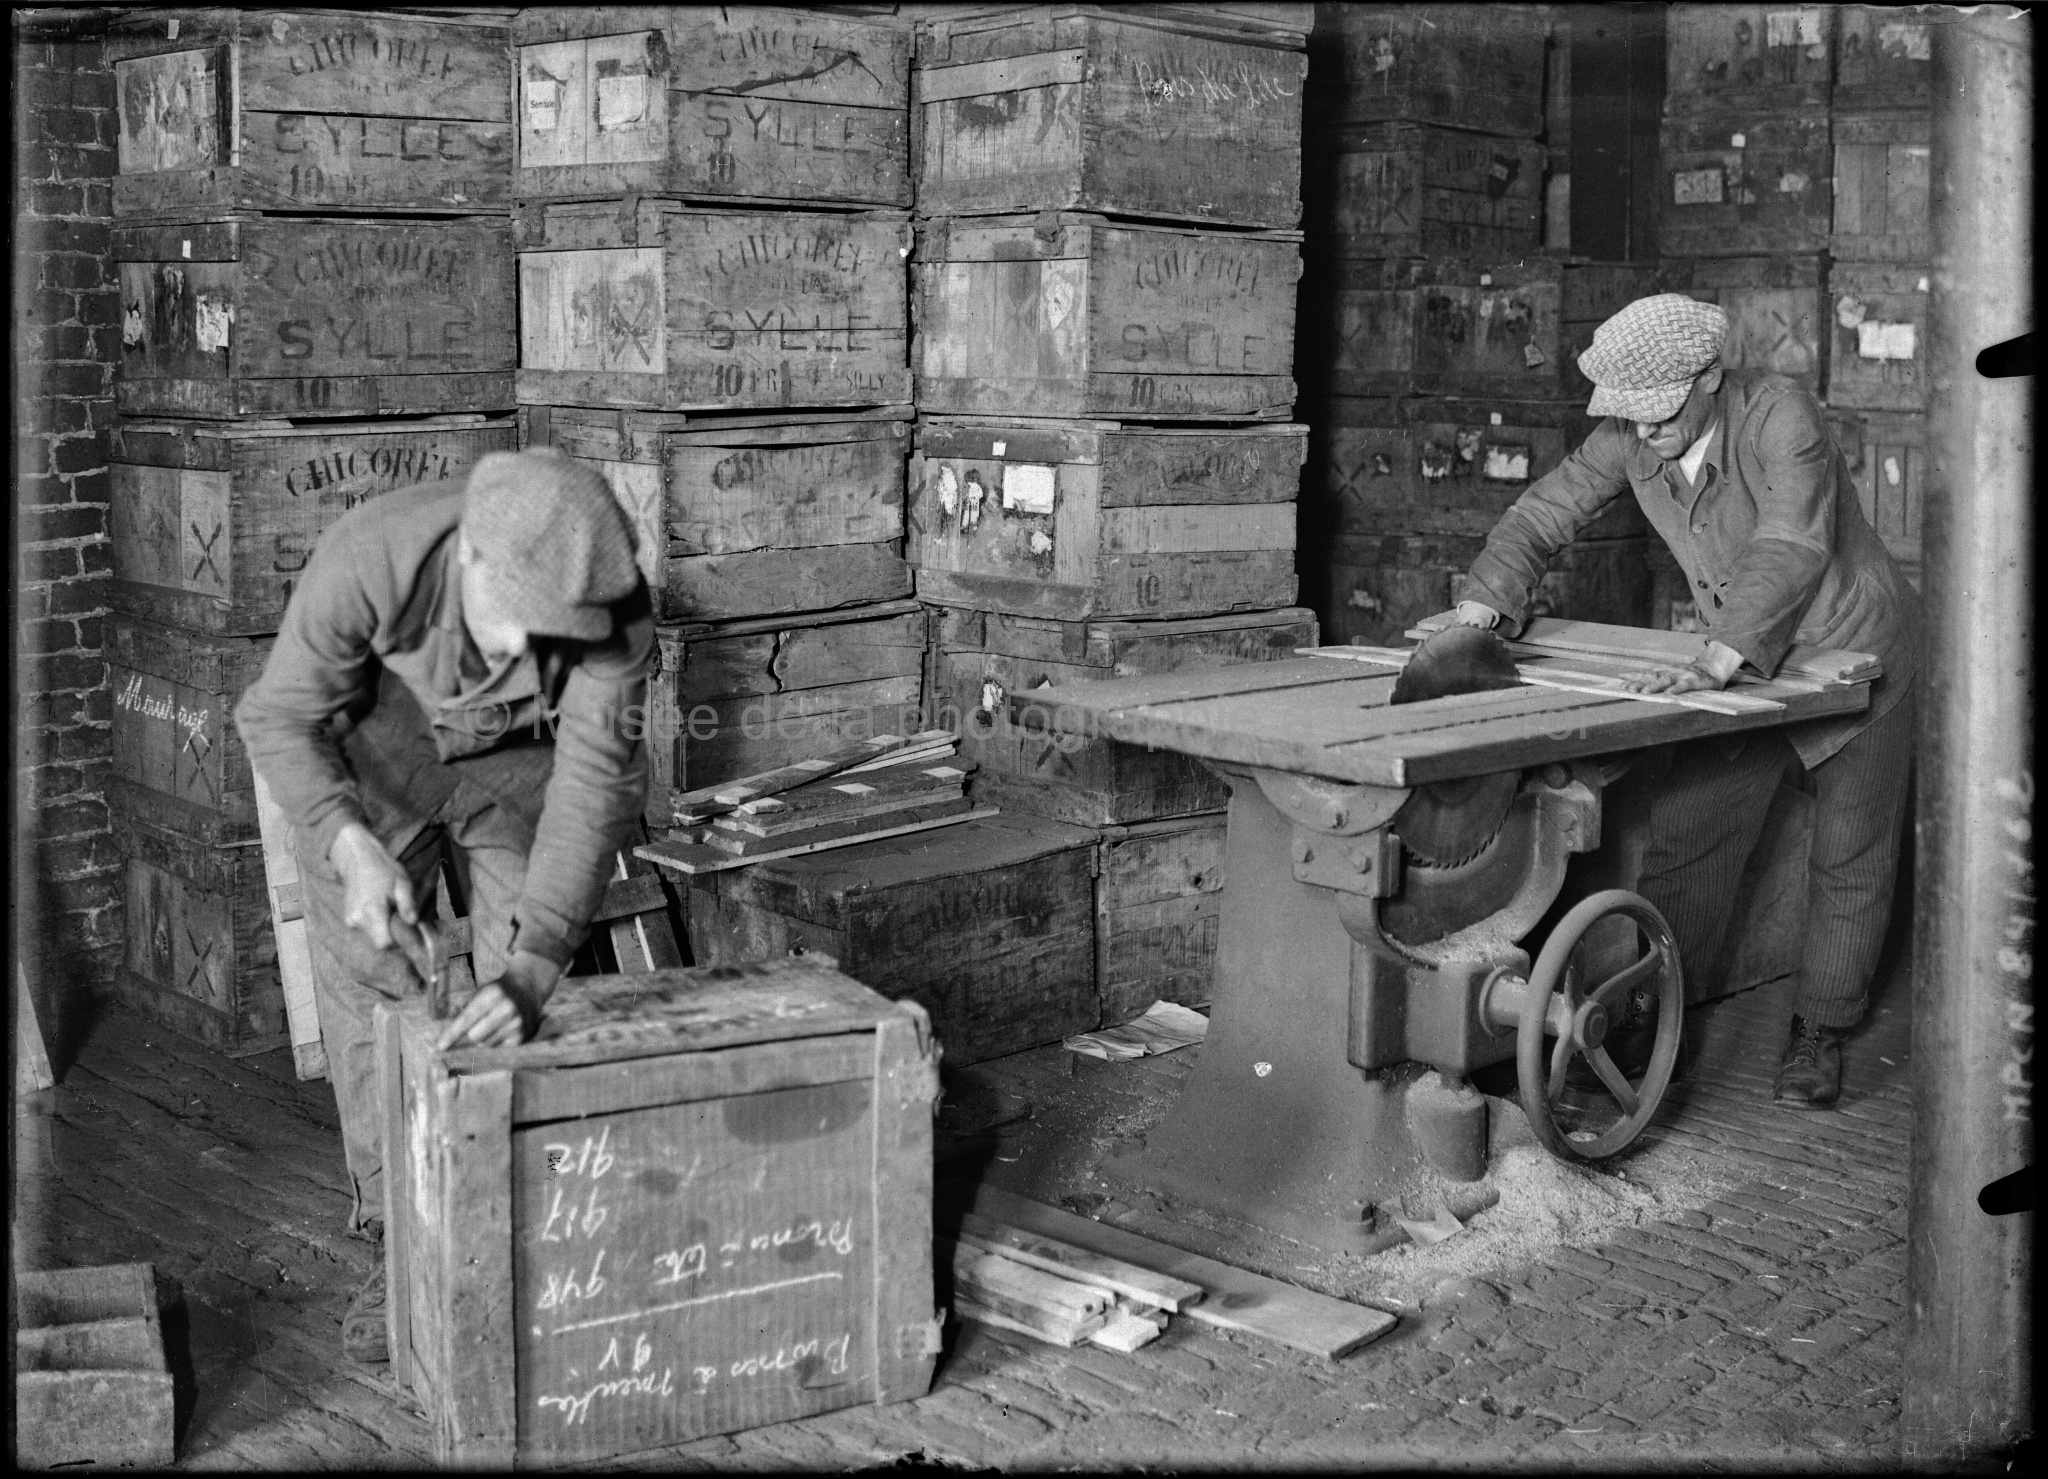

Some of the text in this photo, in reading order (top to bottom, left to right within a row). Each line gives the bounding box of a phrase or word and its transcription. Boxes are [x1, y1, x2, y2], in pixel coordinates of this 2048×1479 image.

[274, 114, 466, 162] SYLLE
[704, 102, 870, 155] SYLLE
[289, 164, 325, 198] 10
[277, 316, 475, 360] SYLLE
[705, 309, 870, 353] SYLLE
[713, 363, 743, 397] 10
[1129, 375, 1156, 408] 10
[543, 1125, 614, 1181] 912
